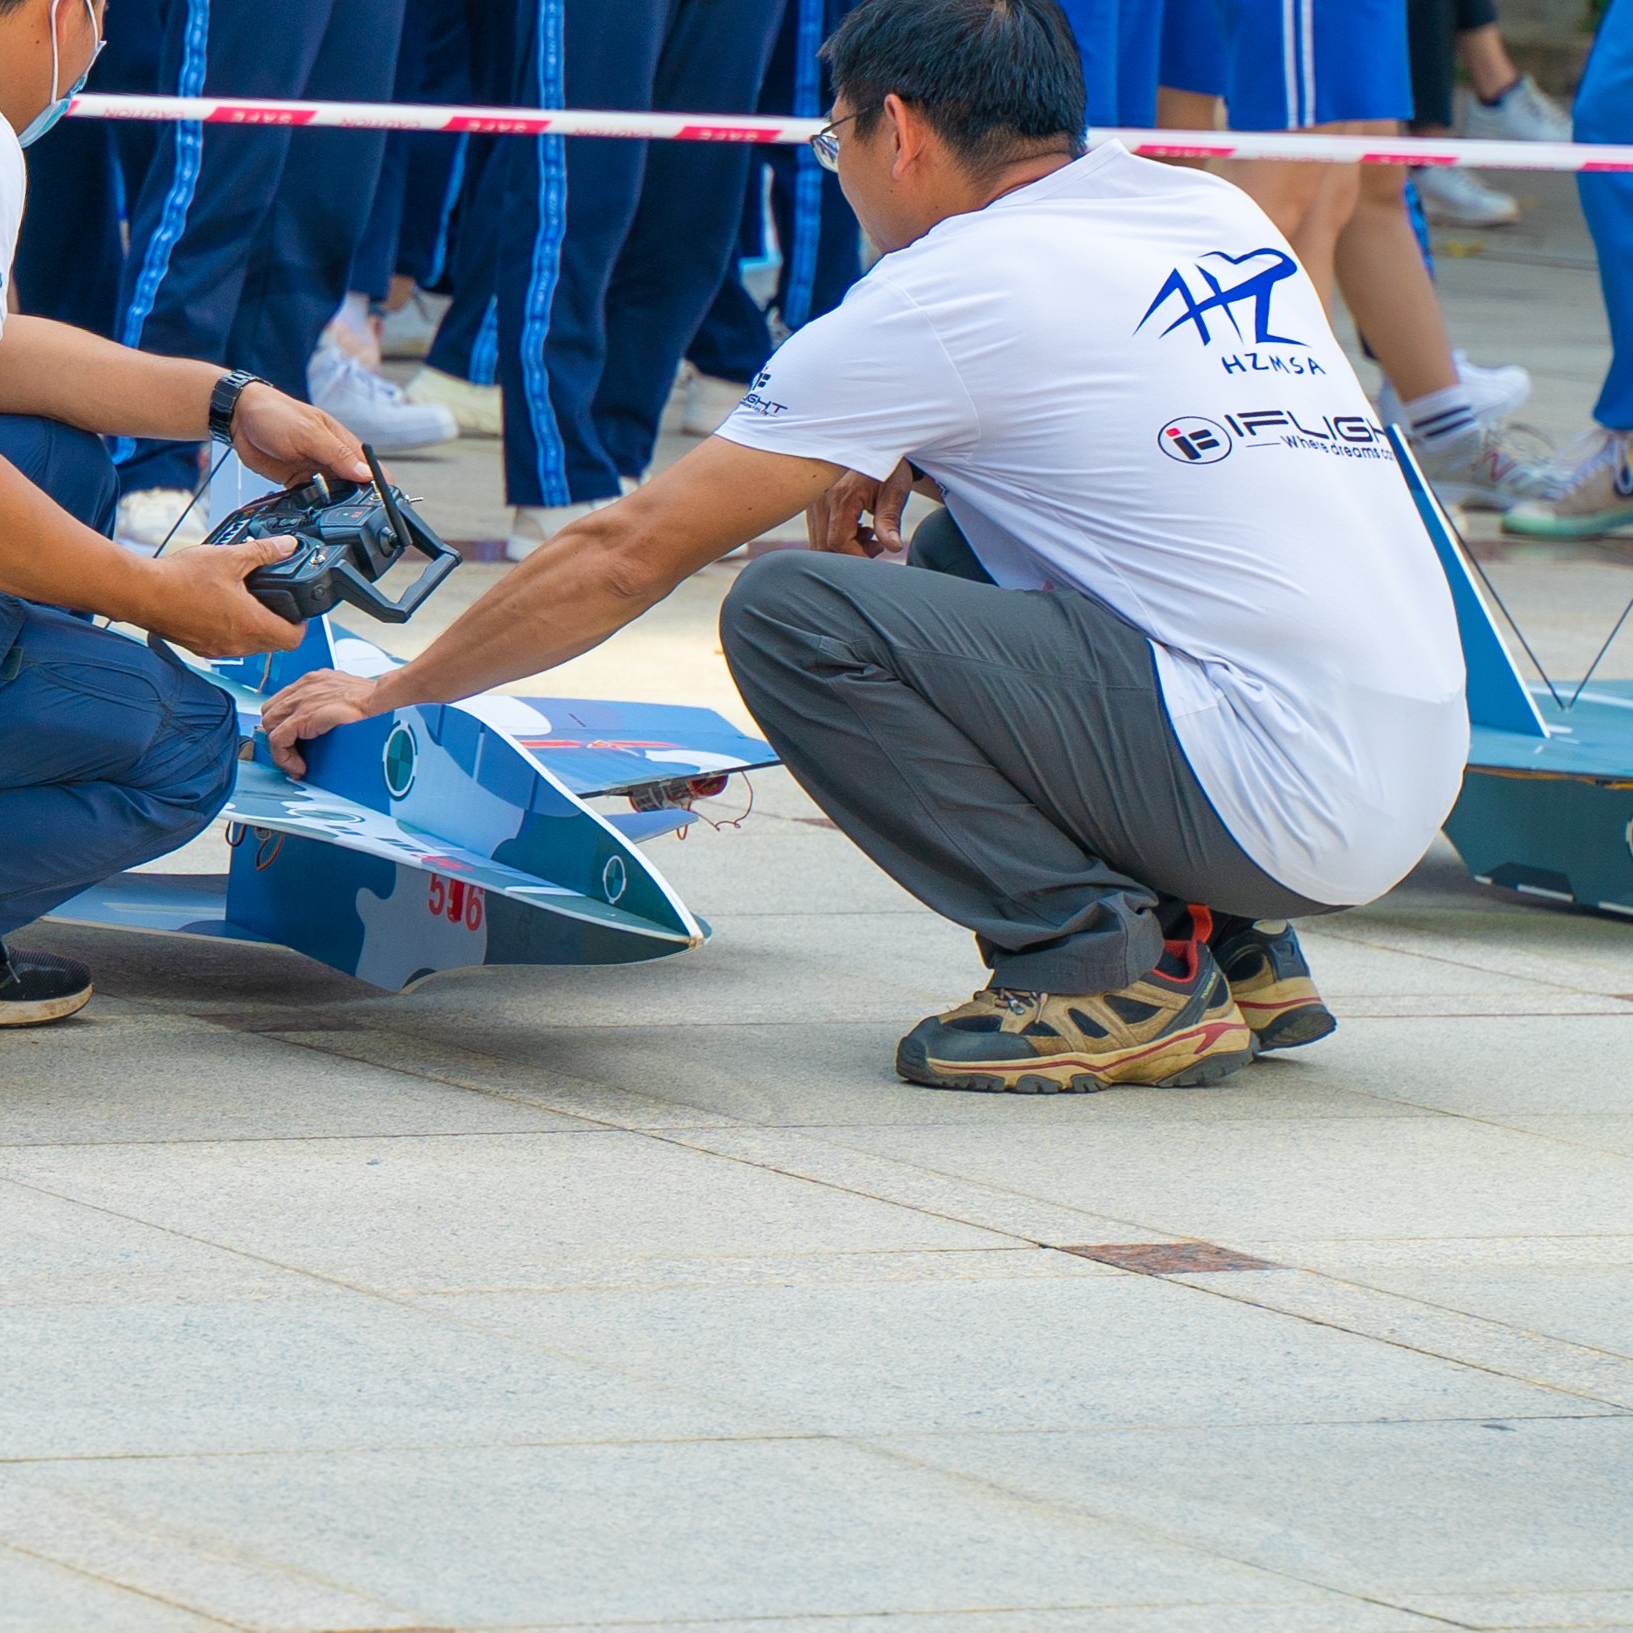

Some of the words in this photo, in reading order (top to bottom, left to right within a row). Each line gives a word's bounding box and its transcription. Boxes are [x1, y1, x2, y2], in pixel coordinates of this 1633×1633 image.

[231, 110, 293, 125] SAFE
[1221, 352, 1327, 376] HZMSA
[1280, 435, 1329, 455] Where
[1330, 438, 1380, 459] dreams
